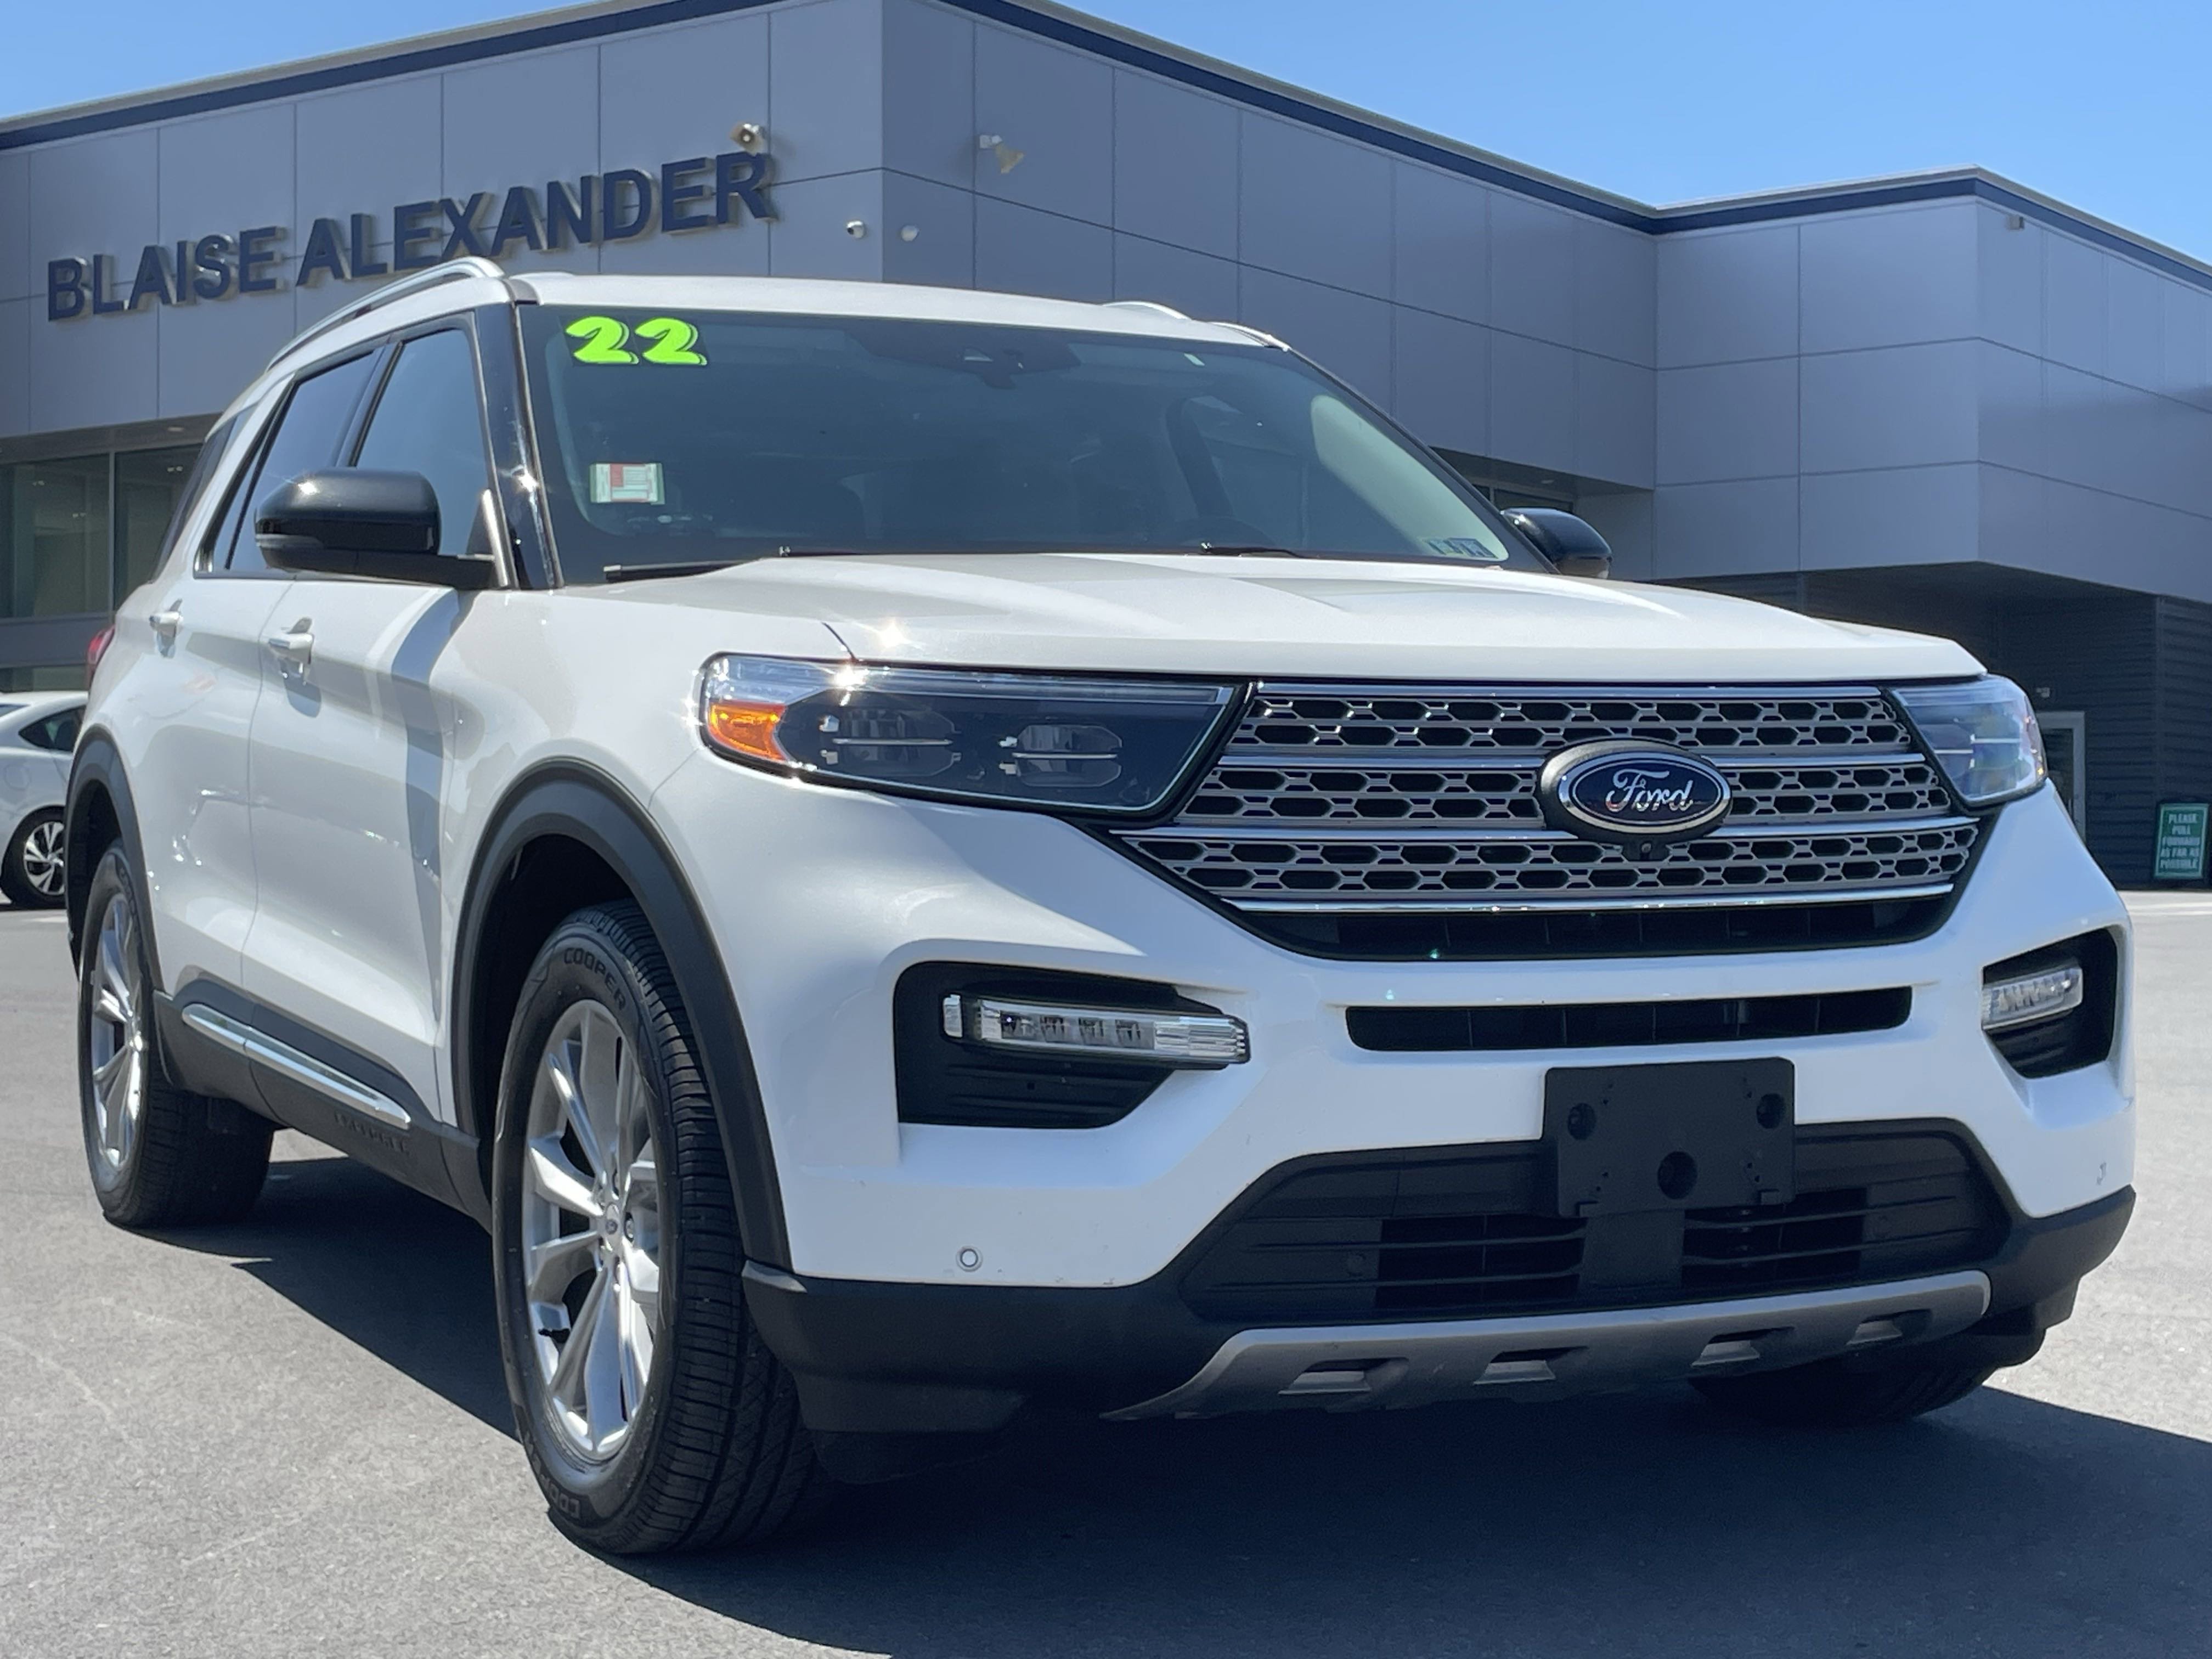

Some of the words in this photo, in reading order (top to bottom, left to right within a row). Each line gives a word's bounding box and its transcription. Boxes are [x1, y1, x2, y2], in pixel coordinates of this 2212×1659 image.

[48, 225, 281, 322] BLAISE
[295, 151, 776, 287] ALEXANDER
[565, 315, 708, 366] 22
[1605, 768, 1695, 812] Ford
[563, 947, 626, 1011] COOPER
